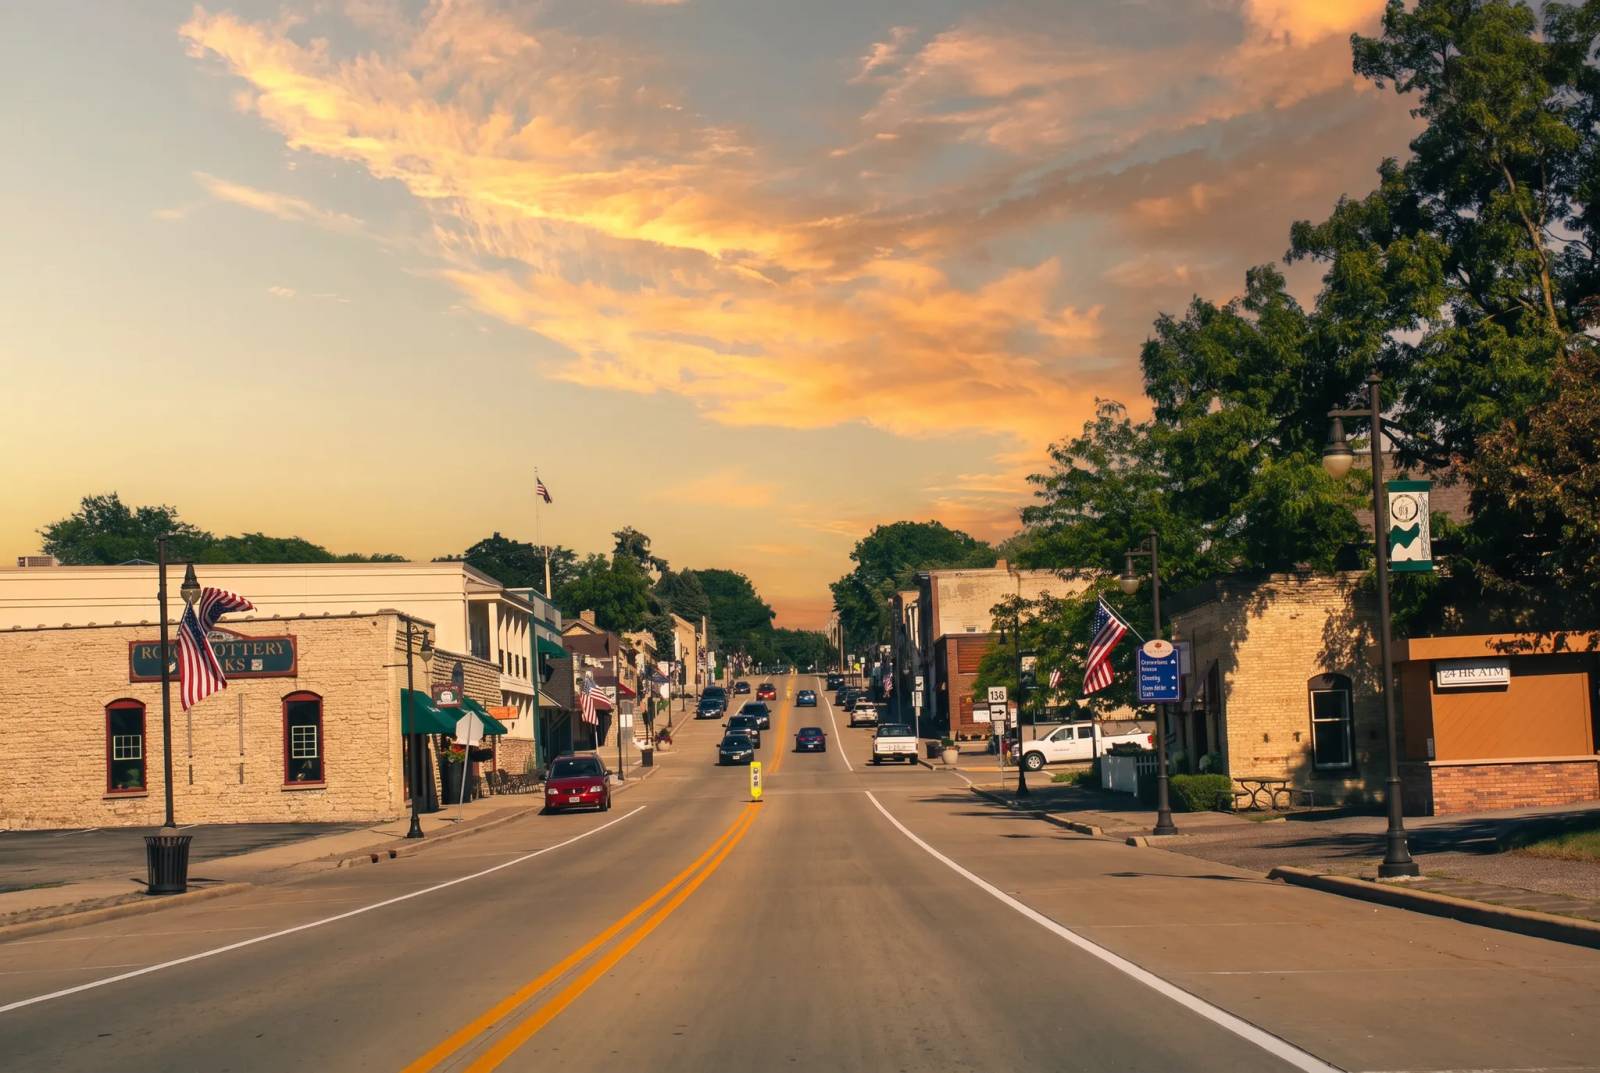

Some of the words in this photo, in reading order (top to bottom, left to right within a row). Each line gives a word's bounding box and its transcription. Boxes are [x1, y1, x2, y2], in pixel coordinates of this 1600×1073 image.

[213, 641, 286, 657] OTTERY
[1459, 668, 1475, 678] HR
[1479, 667, 1504, 677] ATM
